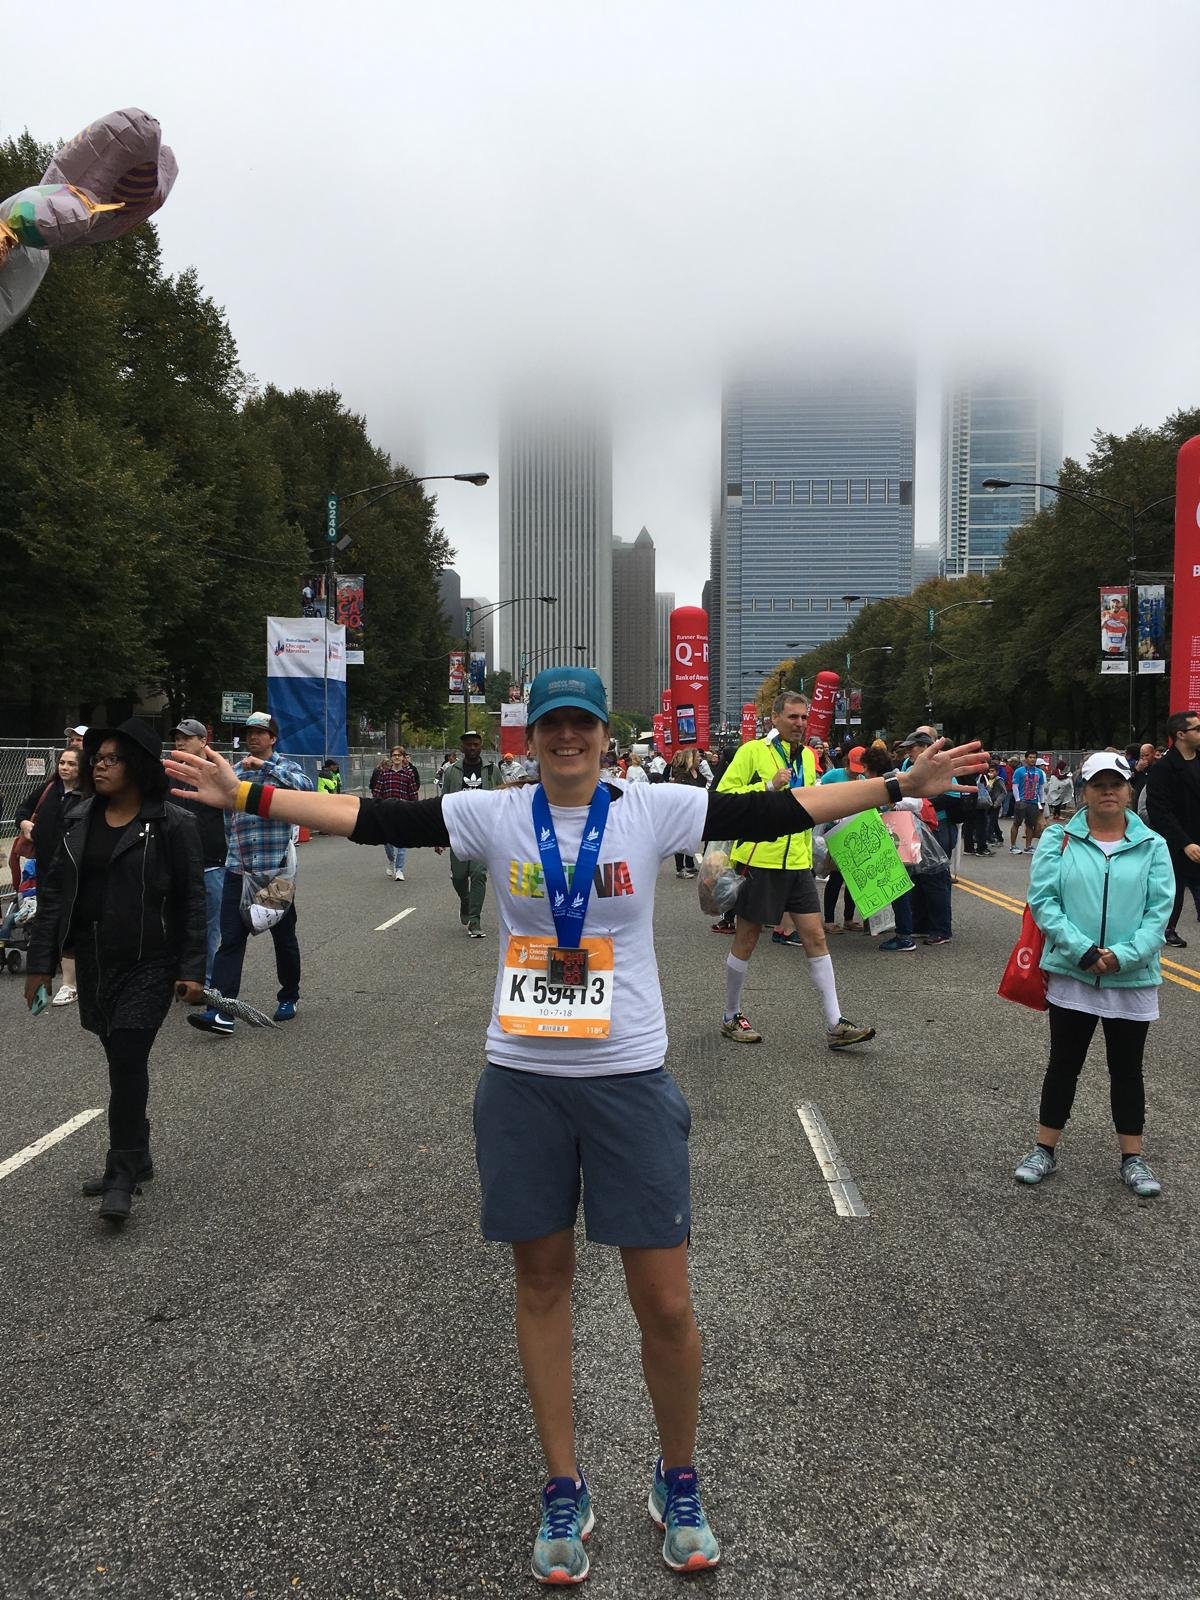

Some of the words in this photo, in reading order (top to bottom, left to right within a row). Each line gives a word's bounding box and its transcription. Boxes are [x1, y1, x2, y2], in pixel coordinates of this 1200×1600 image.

[328, 500, 337, 537] C240
[509, 974, 527, 1003] K
[532, 976, 605, 1005] 59413
